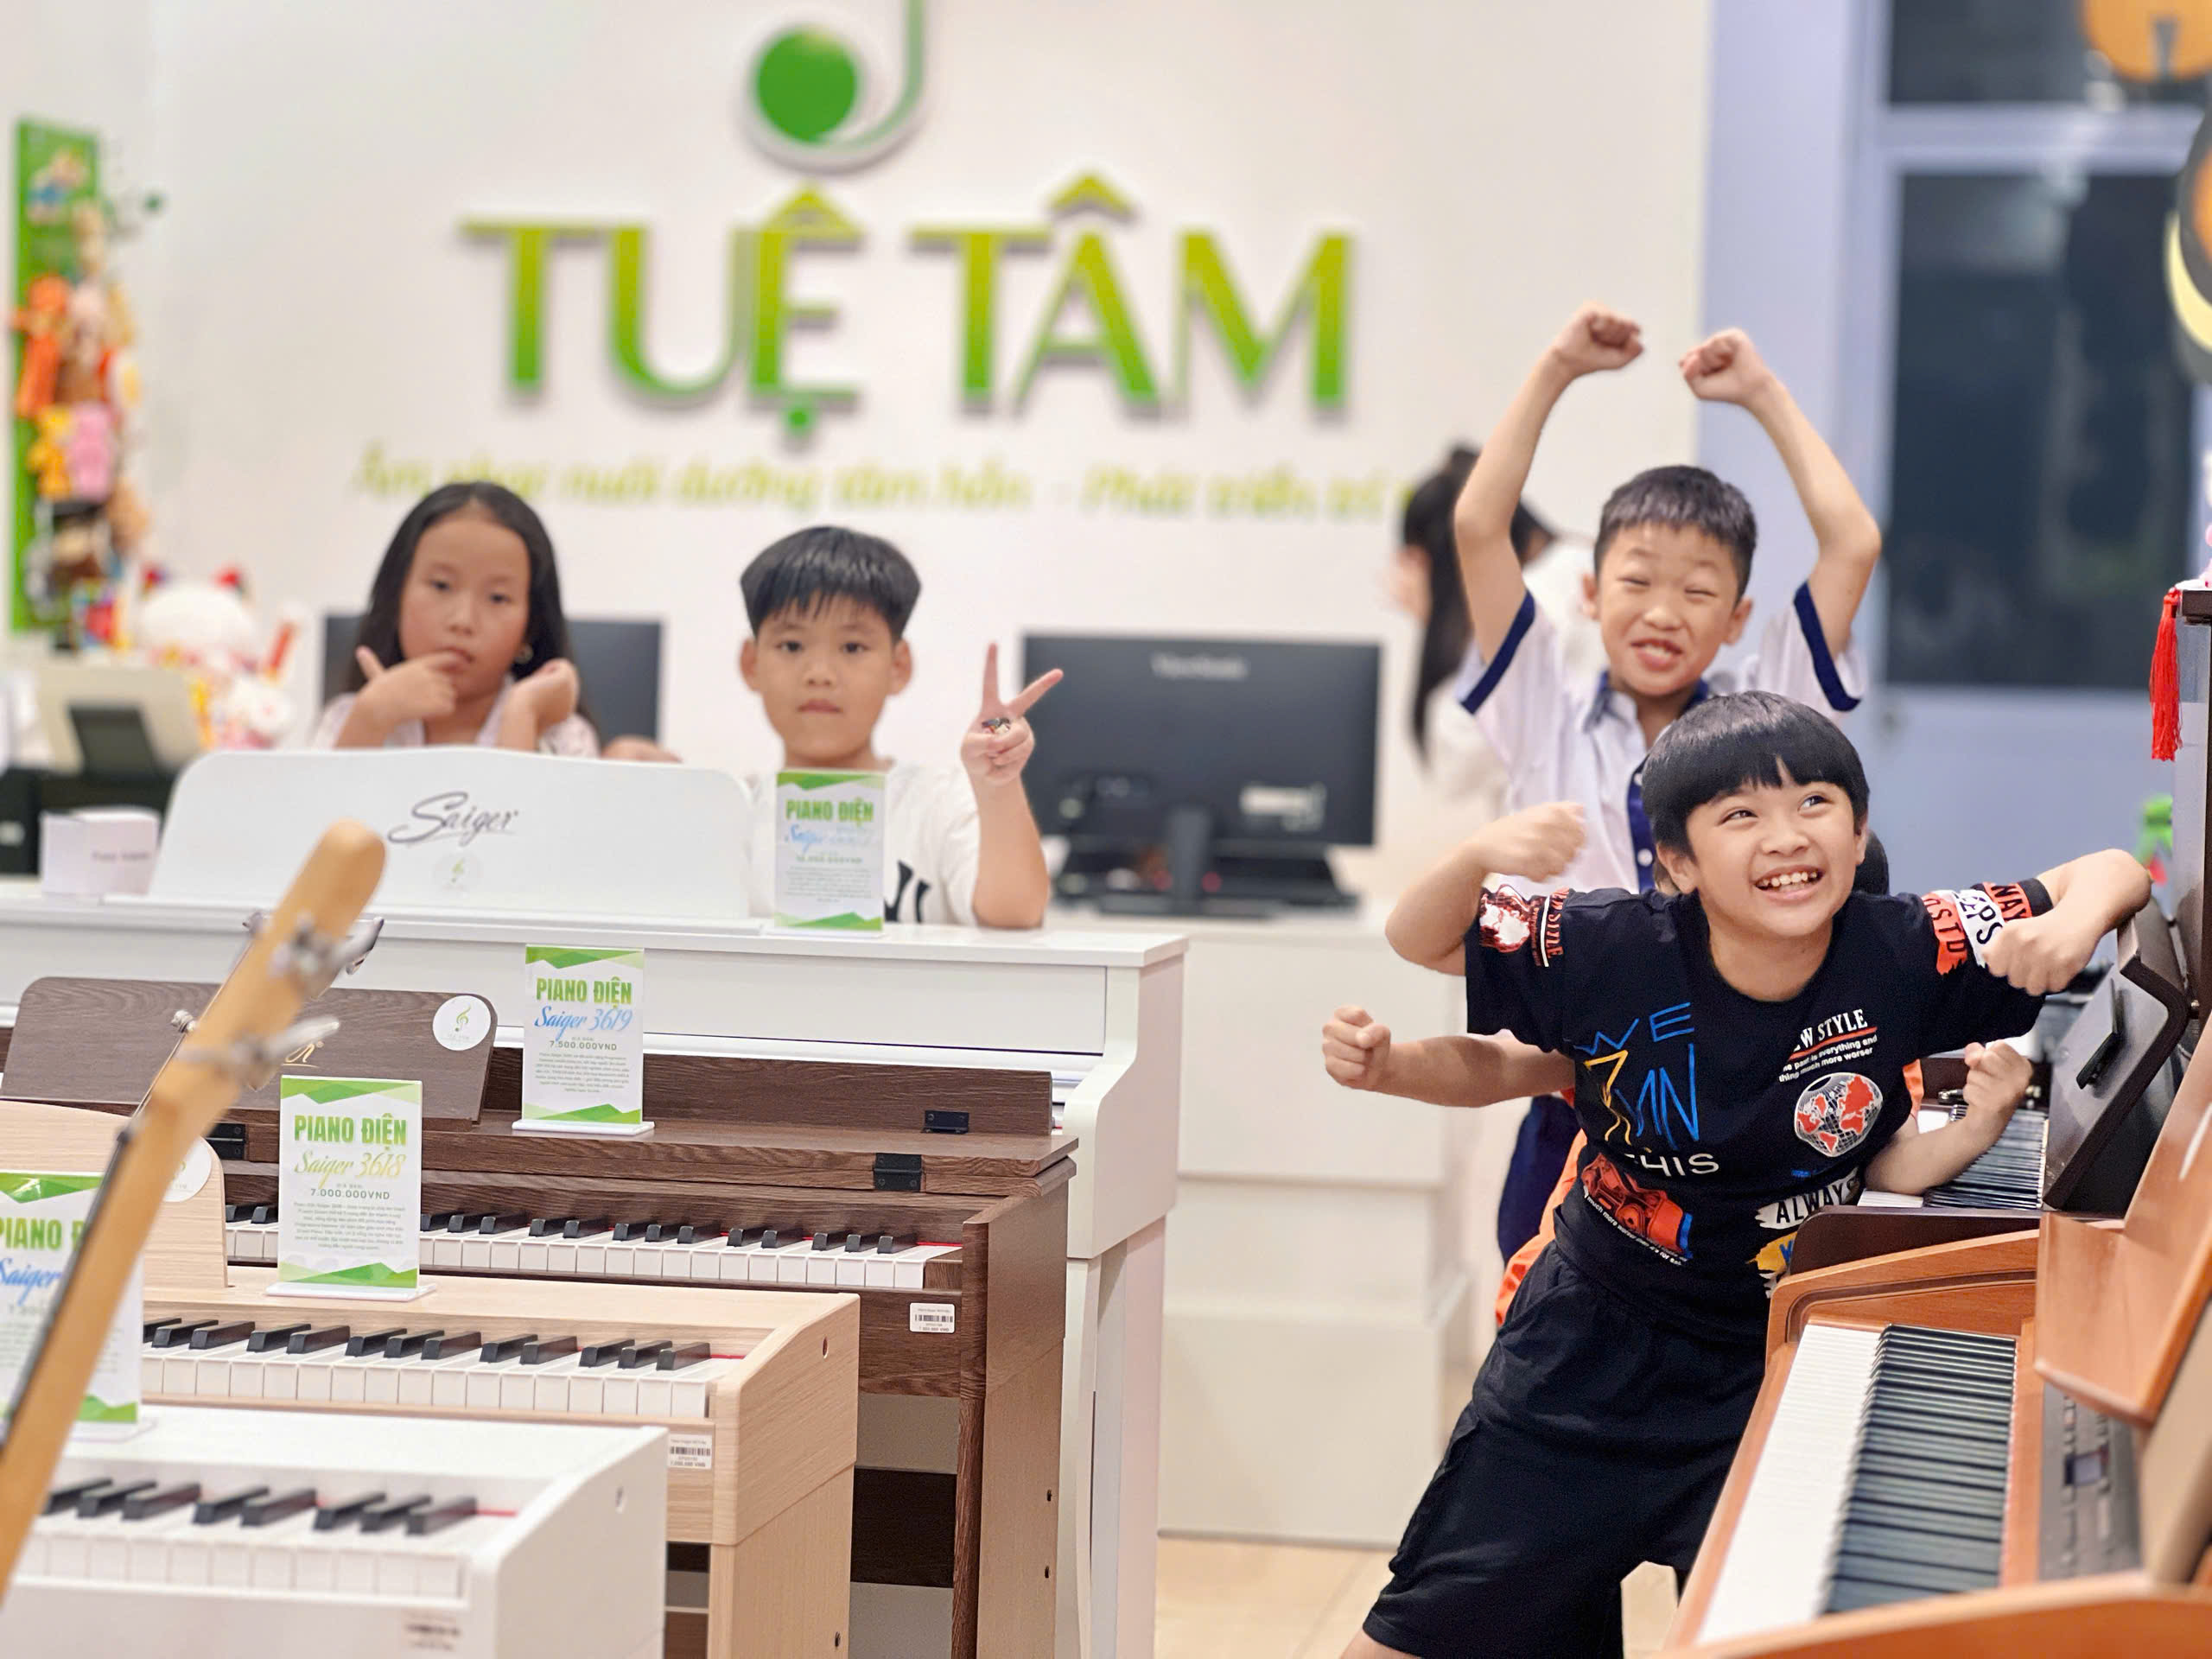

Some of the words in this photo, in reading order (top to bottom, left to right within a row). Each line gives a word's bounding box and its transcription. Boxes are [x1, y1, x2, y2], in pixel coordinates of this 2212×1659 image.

[459, 179, 864, 439] TUỆ
[905, 169, 1358, 416] TÂM
[387, 791, 520, 848] Saiger
[786, 798, 834, 821] PIANO
[536, 977, 588, 1002] PIANO
[593, 976, 632, 1009] ĐIỆN
[533, 1005, 588, 1042] Saiger
[1818, 1009, 1868, 1041] STYLE
[1821, 1054, 1843, 1066] more
[293, 1114, 355, 1143] PIANO
[360, 1112, 407, 1152] ĐIỆN
[293, 1149, 355, 1190] Saiger
